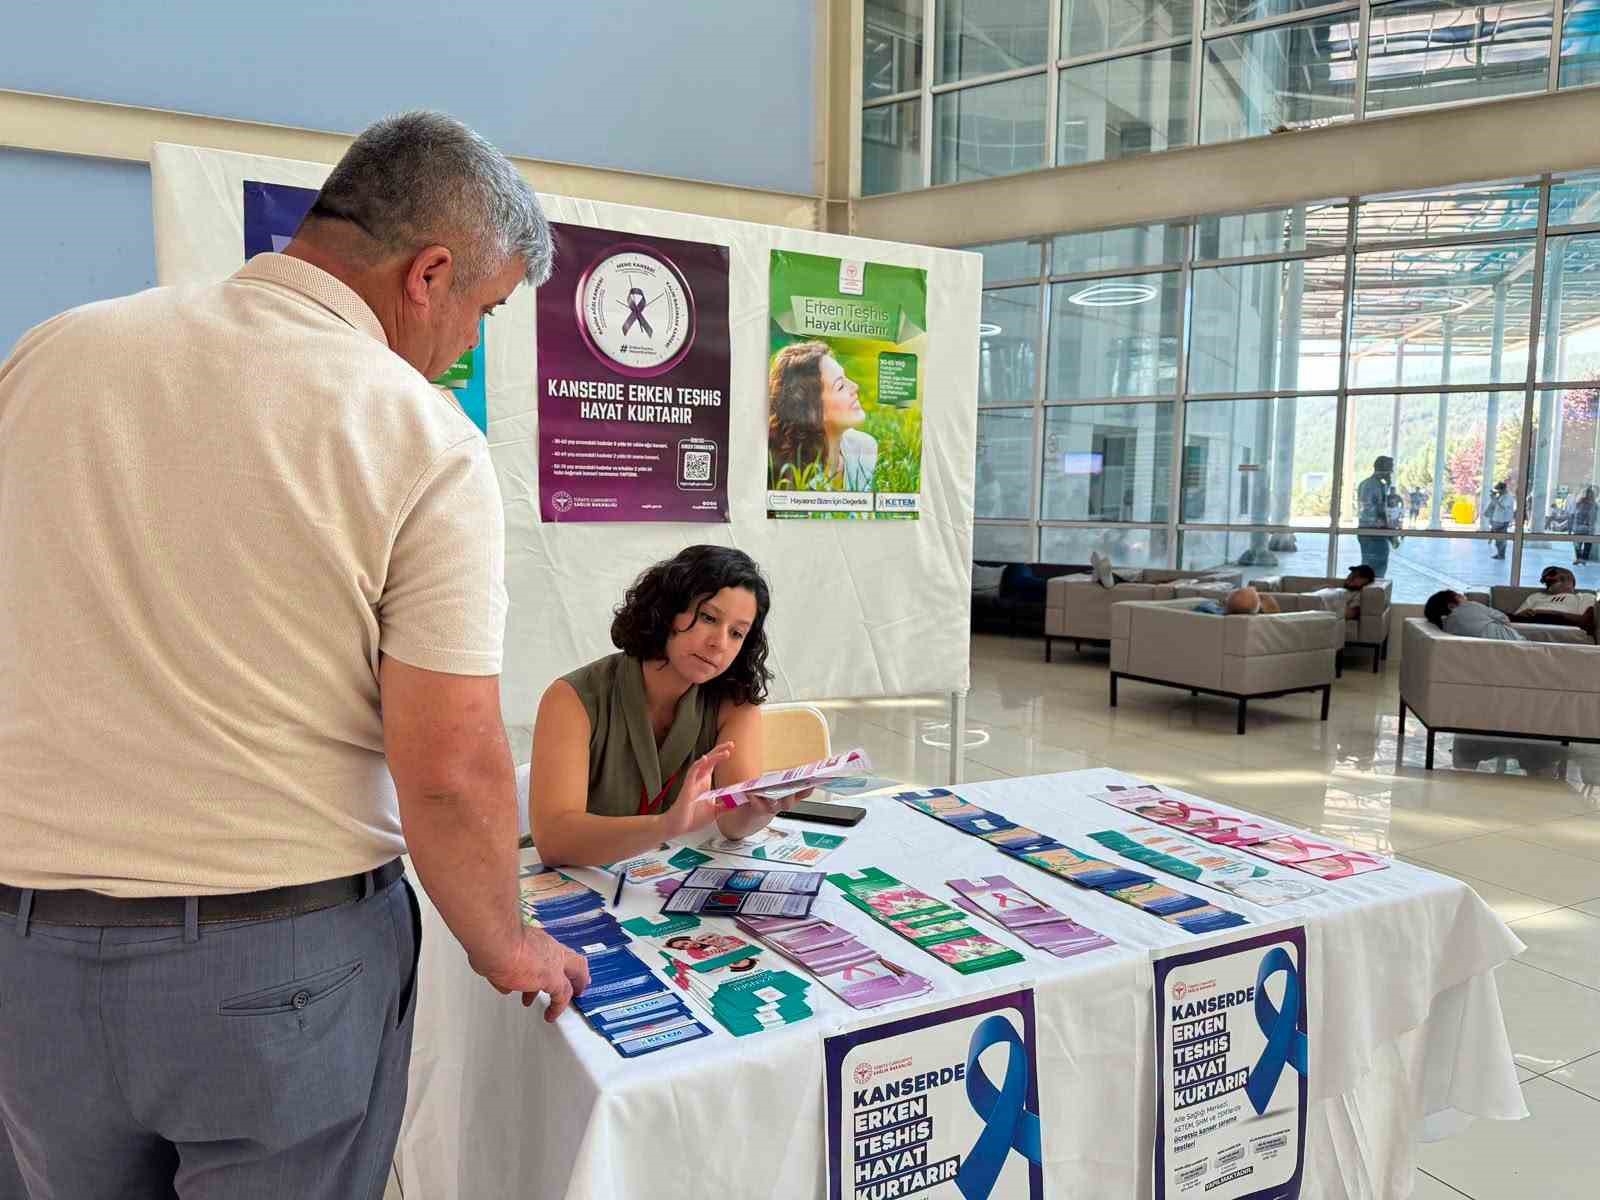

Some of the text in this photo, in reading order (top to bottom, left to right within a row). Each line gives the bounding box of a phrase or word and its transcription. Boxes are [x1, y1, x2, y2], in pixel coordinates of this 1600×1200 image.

[805, 299, 844, 316] Erken
[804, 316, 841, 333] Hayat
[547, 379, 625, 401] KANSERDE
[629, 384, 673, 404] ERKEN
[581, 402, 693, 424] HAYAT KURTARIR
[885, 498, 916, 507] KETEM
[1171, 986, 1255, 1021] KANSERDE
[648, 1030, 682, 1043] KETEM
[1173, 1016, 1225, 1043] ERKEN
[1174, 1058, 1226, 1085] HAYAT
[853, 1063, 966, 1109] KANSERDE
[1174, 1070, 1248, 1108] KURTARIR
[854, 1098, 925, 1133] ERKEN
[855, 1146, 926, 1184] HAYAT
[855, 1159, 958, 1200] KURTARIR
